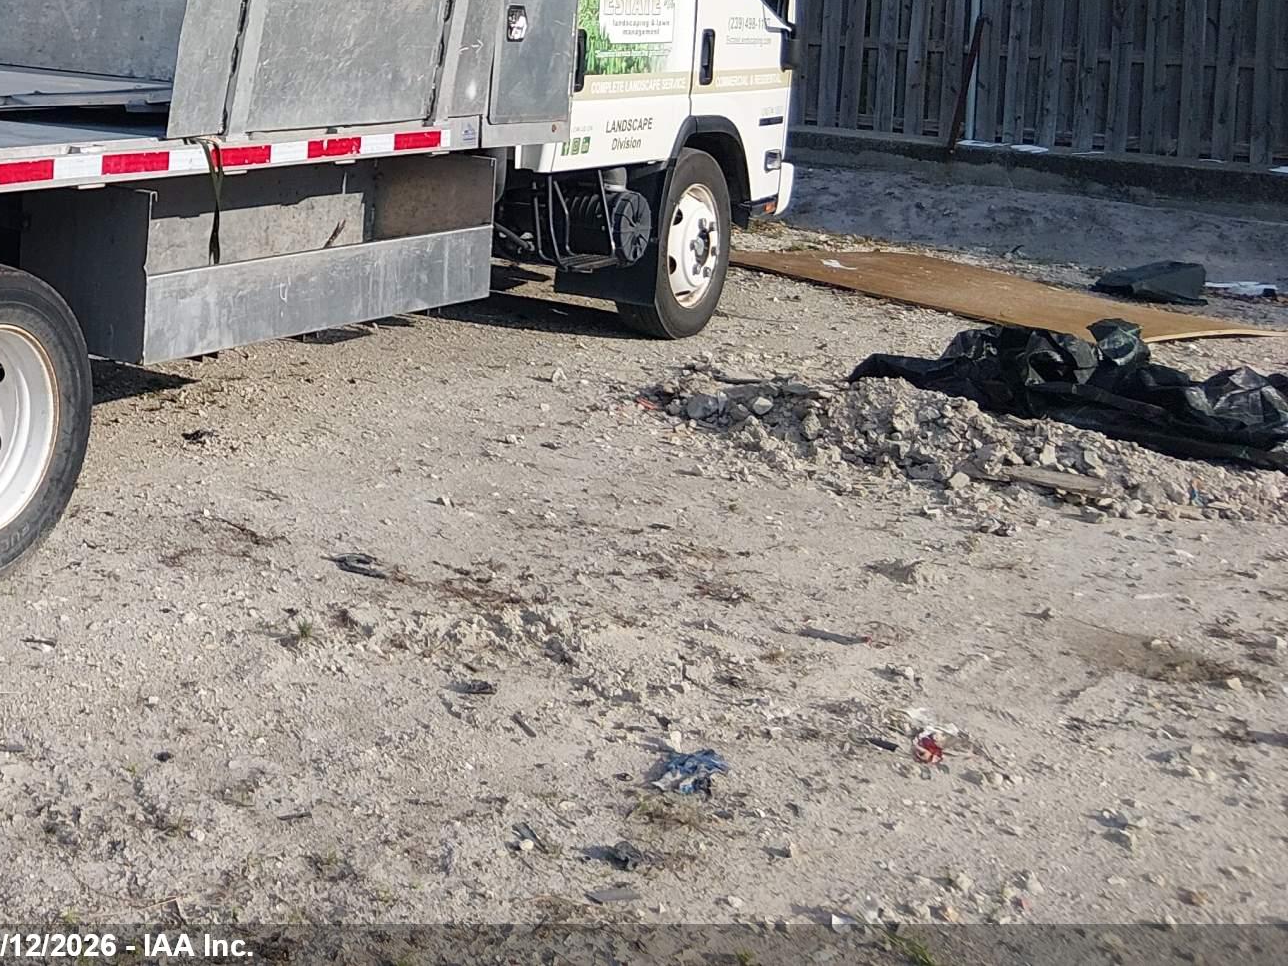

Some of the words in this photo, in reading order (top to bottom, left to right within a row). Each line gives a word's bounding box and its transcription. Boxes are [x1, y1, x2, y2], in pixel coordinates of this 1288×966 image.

[612, 18, 649, 27] landscaping
[591, 81, 624, 94] COMPLETE
[625, 78, 660, 92] LANDSCAPE
[605, 117, 653, 134] LANDSCAPE
[611, 137, 642, 151] Division
